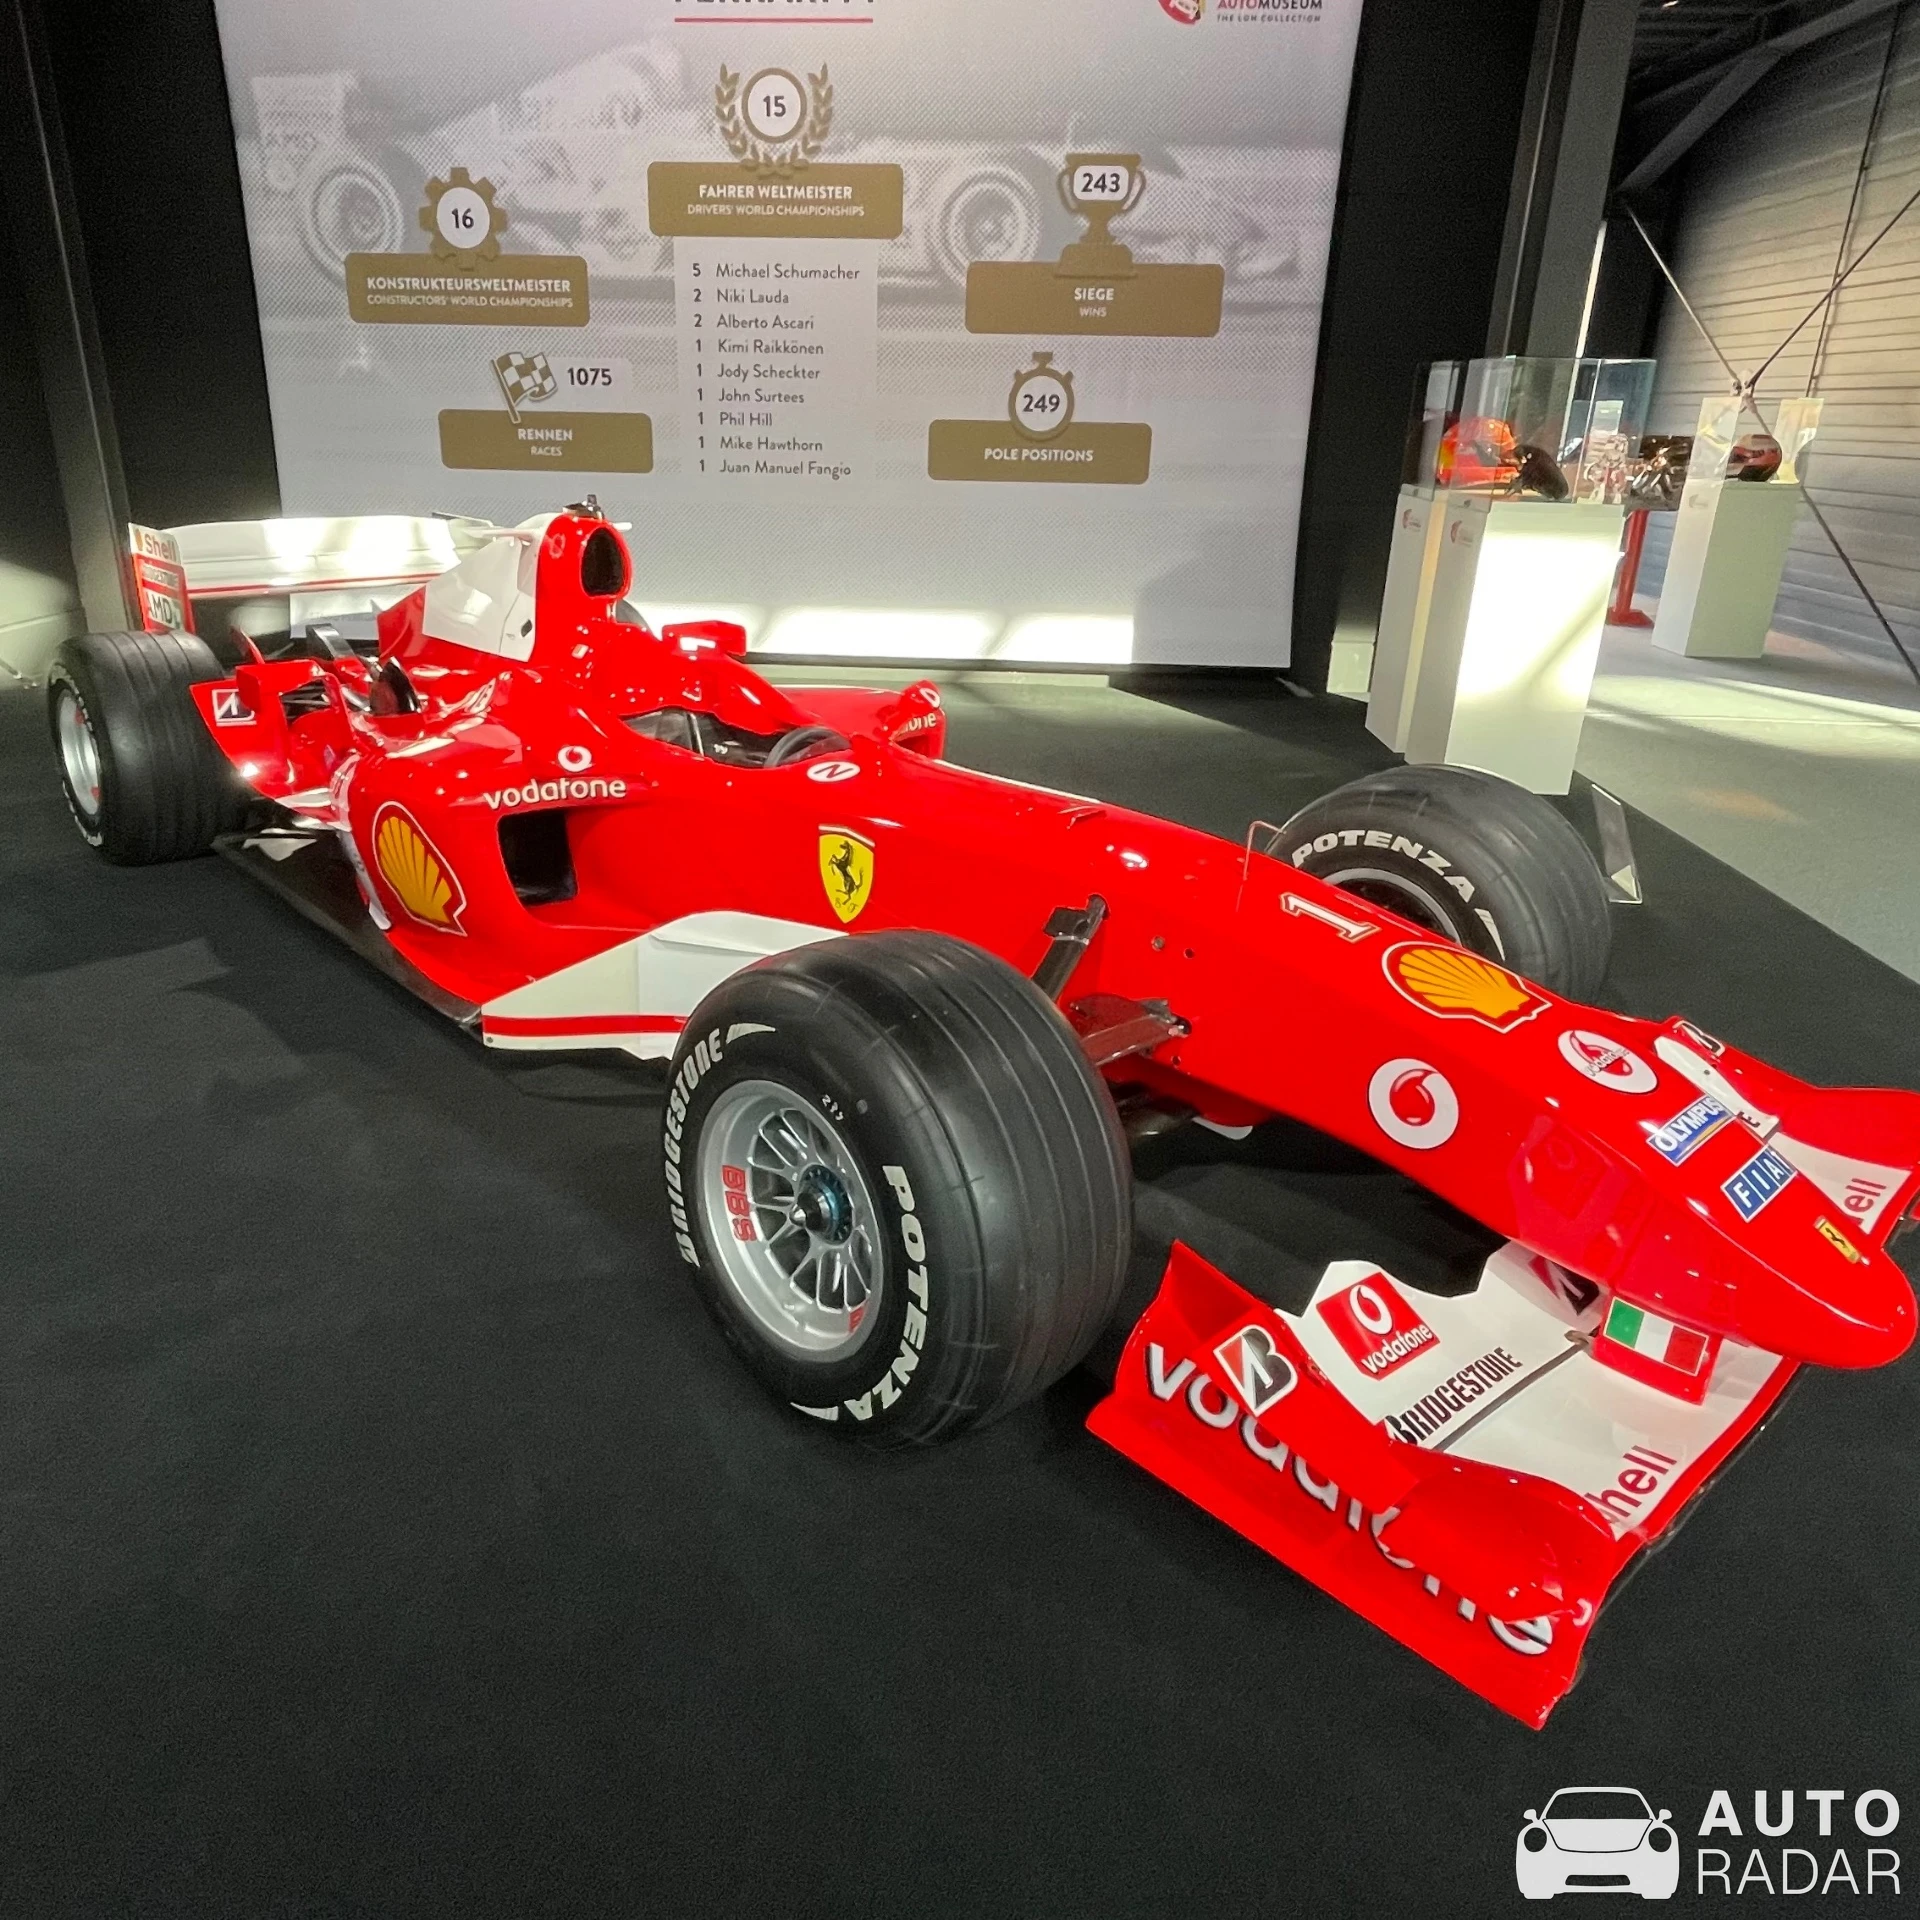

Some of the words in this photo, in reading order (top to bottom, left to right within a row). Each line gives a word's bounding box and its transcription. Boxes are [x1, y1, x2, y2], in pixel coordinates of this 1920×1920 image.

[1217, 14, 1234, 22] THE
[1261, 14, 1321, 23] COLLECTION
[763, 95, 787, 117] 15
[699, 184, 755, 199] FAHRER
[758, 185, 853, 199] WELTMEISTER
[1081, 172, 1121, 193] 243
[452, 207, 475, 229] 16
[736, 204, 775, 216] WORLD
[776, 205, 865, 217] CHAMPIONSHIPS
[692, 263, 702, 277] 5
[716, 263, 770, 279] Michael
[774, 264, 861, 280] Schumacher
[367, 277, 571, 292] KONSTRUKTEURSWELTMEISTER
[450, 296, 488, 306] WORLD
[489, 297, 574, 308] CHAMPIONSHIPS
[693, 289, 702, 303] 2
[716, 289, 745, 303] Niki
[750, 289, 790, 304] Lauda
[1074, 288, 1115, 301] SIEGE
[1079, 306, 1107, 318] WINS
[694, 314, 703, 327] 2
[716, 314, 769, 329] Alberto
[772, 315, 814, 330] Ascari
[696, 339, 702, 352] 1
[718, 339, 749, 353] Kimi
[753, 339, 824, 355] Raikkönen
[567, 367, 612, 386] 1075
[697, 363, 703, 377] 1
[717, 363, 749, 383] Jody
[753, 364, 821, 379] Scheckter
[697, 388, 703, 401] 1
[718, 388, 751, 402] John
[754, 388, 805, 403] Surtees
[1022, 394, 1060, 413] 249
[698, 411, 704, 425] 1
[719, 411, 745, 426] Phil
[750, 412, 773, 426] Hill
[517, 428, 573, 441] RENNEN
[699, 435, 704, 449] 1
[720, 436, 753, 450] Mike
[757, 436, 823, 451] Hawthorn
[530, 446, 563, 457] RACES
[984, 447, 1019, 461] POLE
[1021, 448, 1094, 462] POSITIONS
[699, 459, 705, 473] 1
[719, 459, 751, 474] Juan
[755, 460, 804, 475] Manuel
[808, 461, 852, 481] Fangio
[144, 533, 177, 562] Shell
[483, 777, 627, 810] vodafone
[1291, 829, 1476, 904] POTENZA
[1279, 891, 1382, 944] 1
[1655, 1097, 1726, 1152] OLYMPUS
[664, 1027, 724, 1270] BRIDGESTONE
[722, 1164, 758, 1242] BBS
[1844, 1178, 1887, 1226] ell
[844, 1164, 929, 1422] POTENZA
[1361, 1322, 1434, 1375] vodafone
[1384, 1346, 1524, 1446] BRIDGESTONE
[1584, 1444, 1677, 1525] hell
